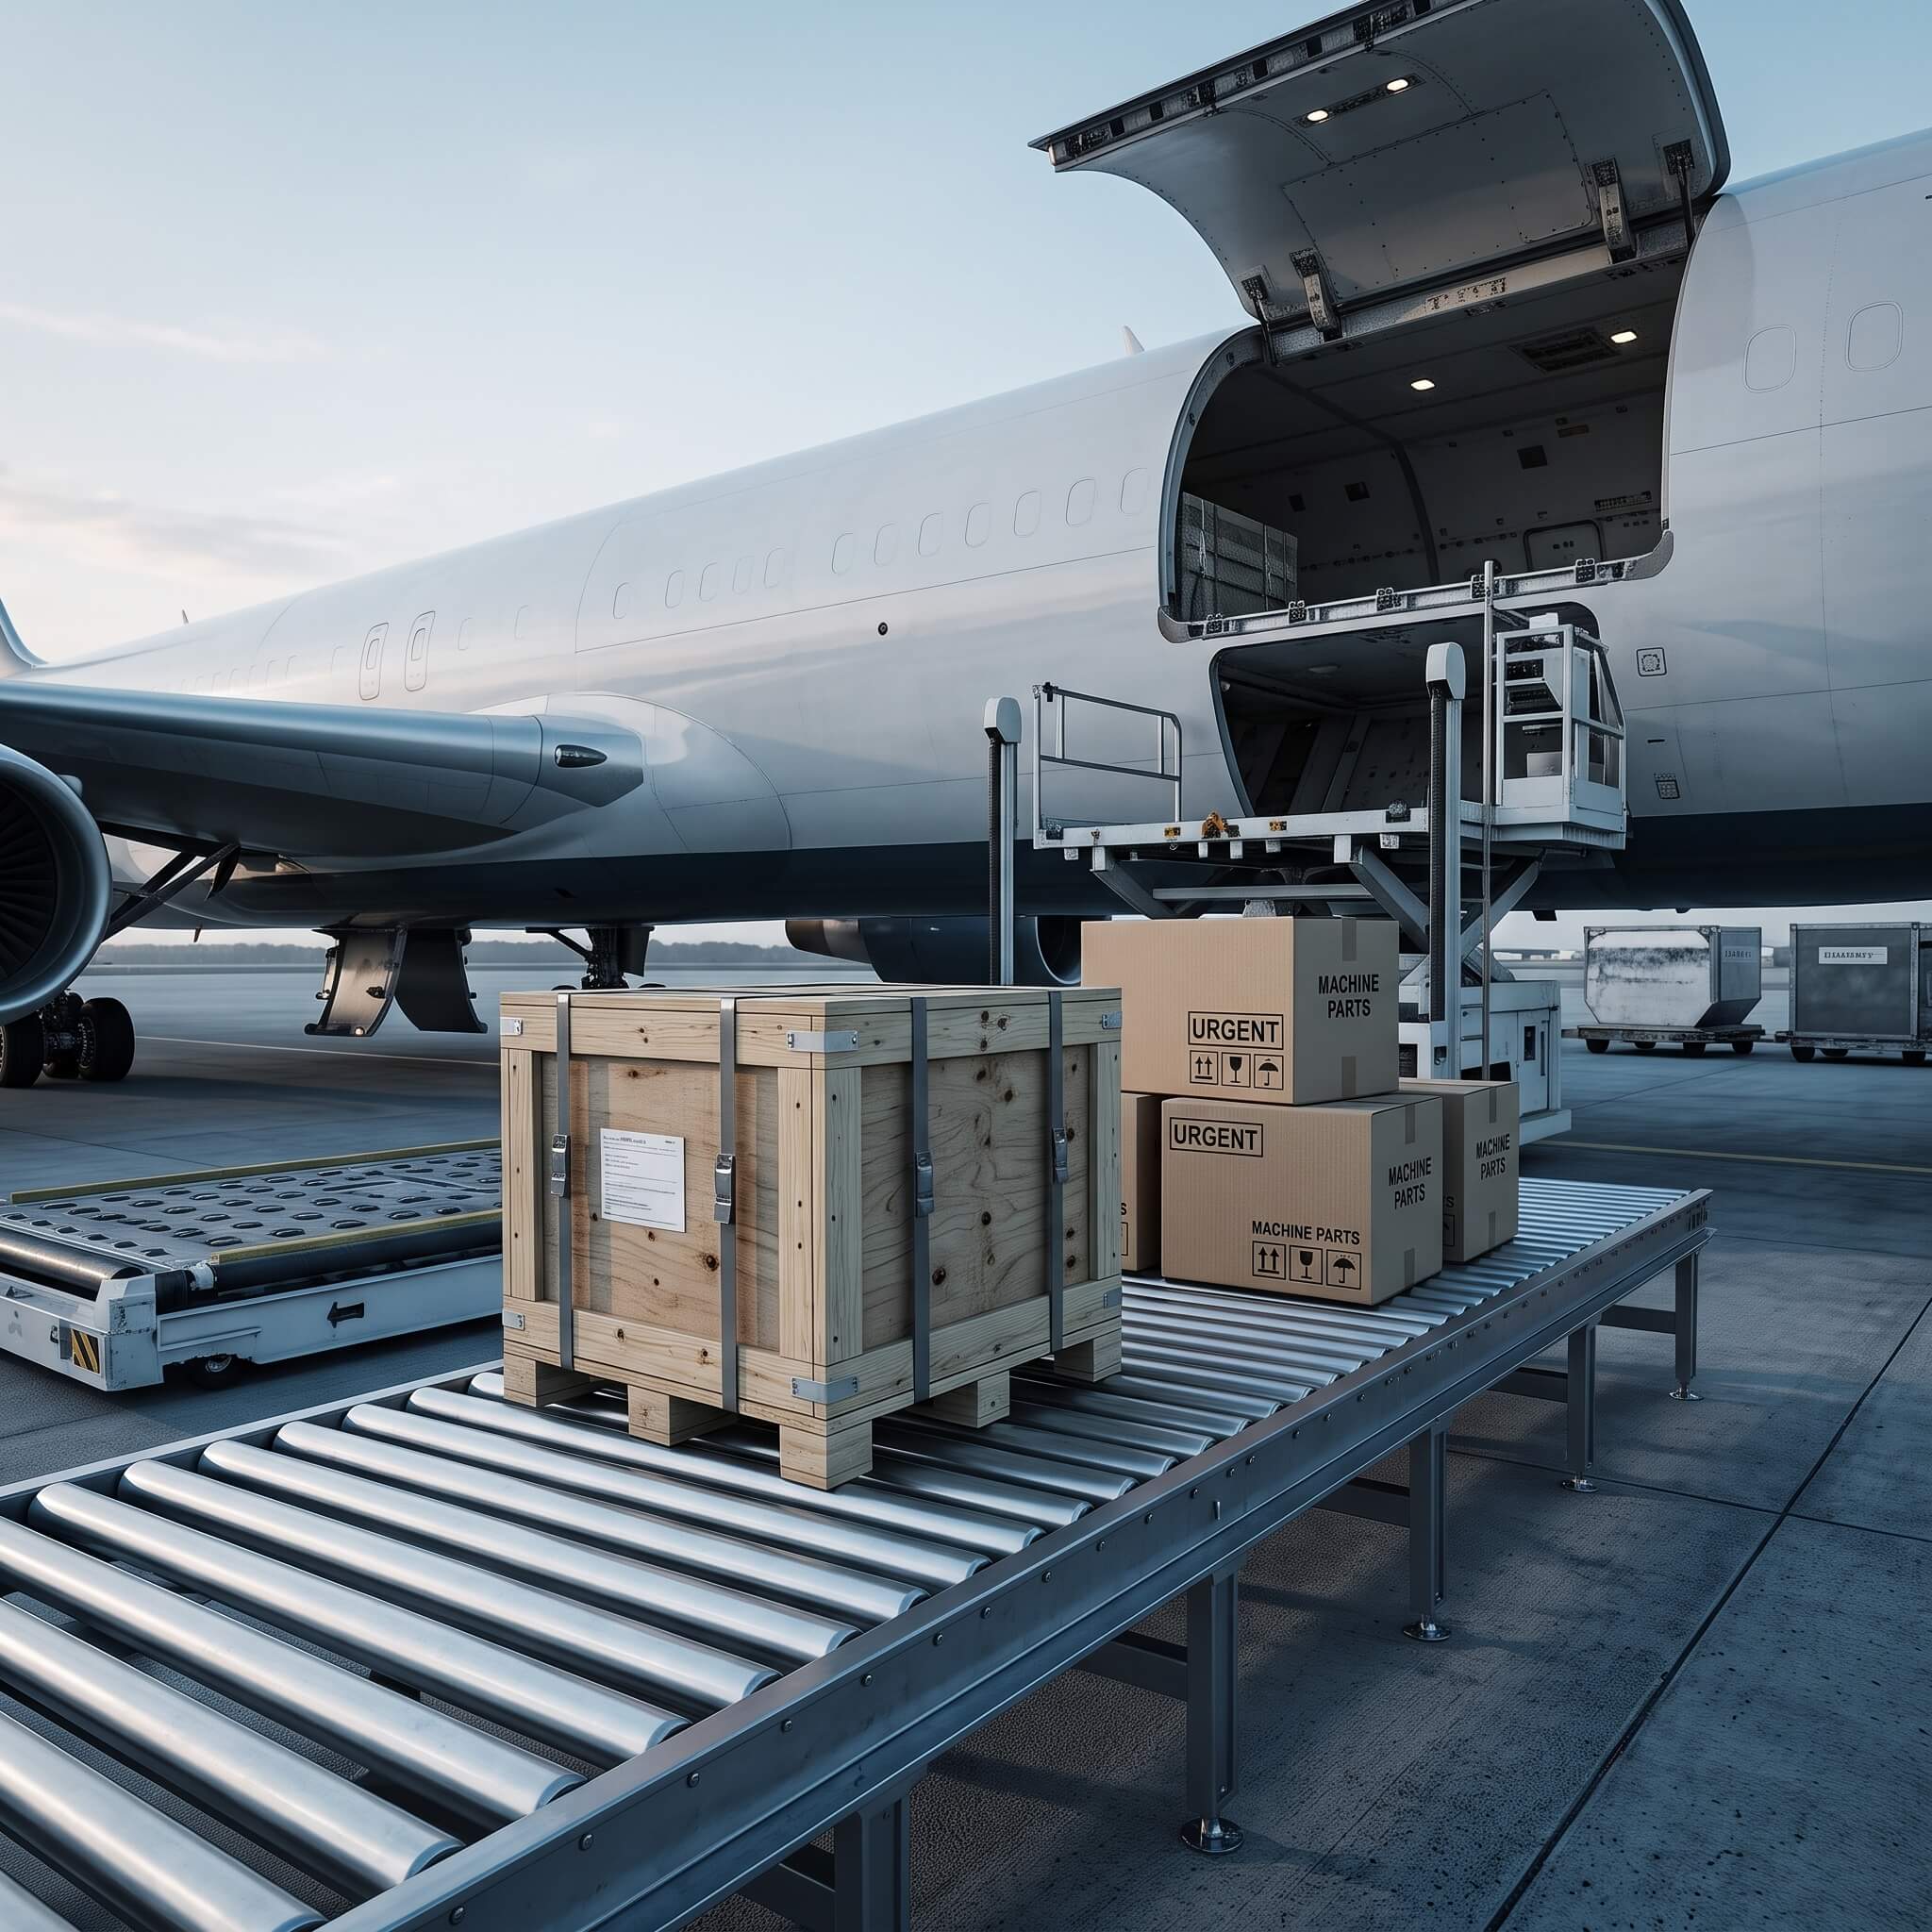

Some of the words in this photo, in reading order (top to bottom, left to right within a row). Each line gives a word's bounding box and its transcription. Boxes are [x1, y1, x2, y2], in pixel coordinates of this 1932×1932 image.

[1318, 974, 1379, 994] MACHINE
[1327, 998, 1371, 1019] PARTS
[1192, 1018, 1279, 1042] URGENT
[1174, 1124, 1257, 1150] URGENT
[1475, 1133, 1510, 1159] MACHINE
[1389, 1157, 1432, 1187] MACHINE
[1480, 1157, 1506, 1181] PARTS
[1394, 1183, 1425, 1210] PARTS
[1252, 1220, 1312, 1241] MACHINE
[1316, 1227, 1360, 1245] PARTS
